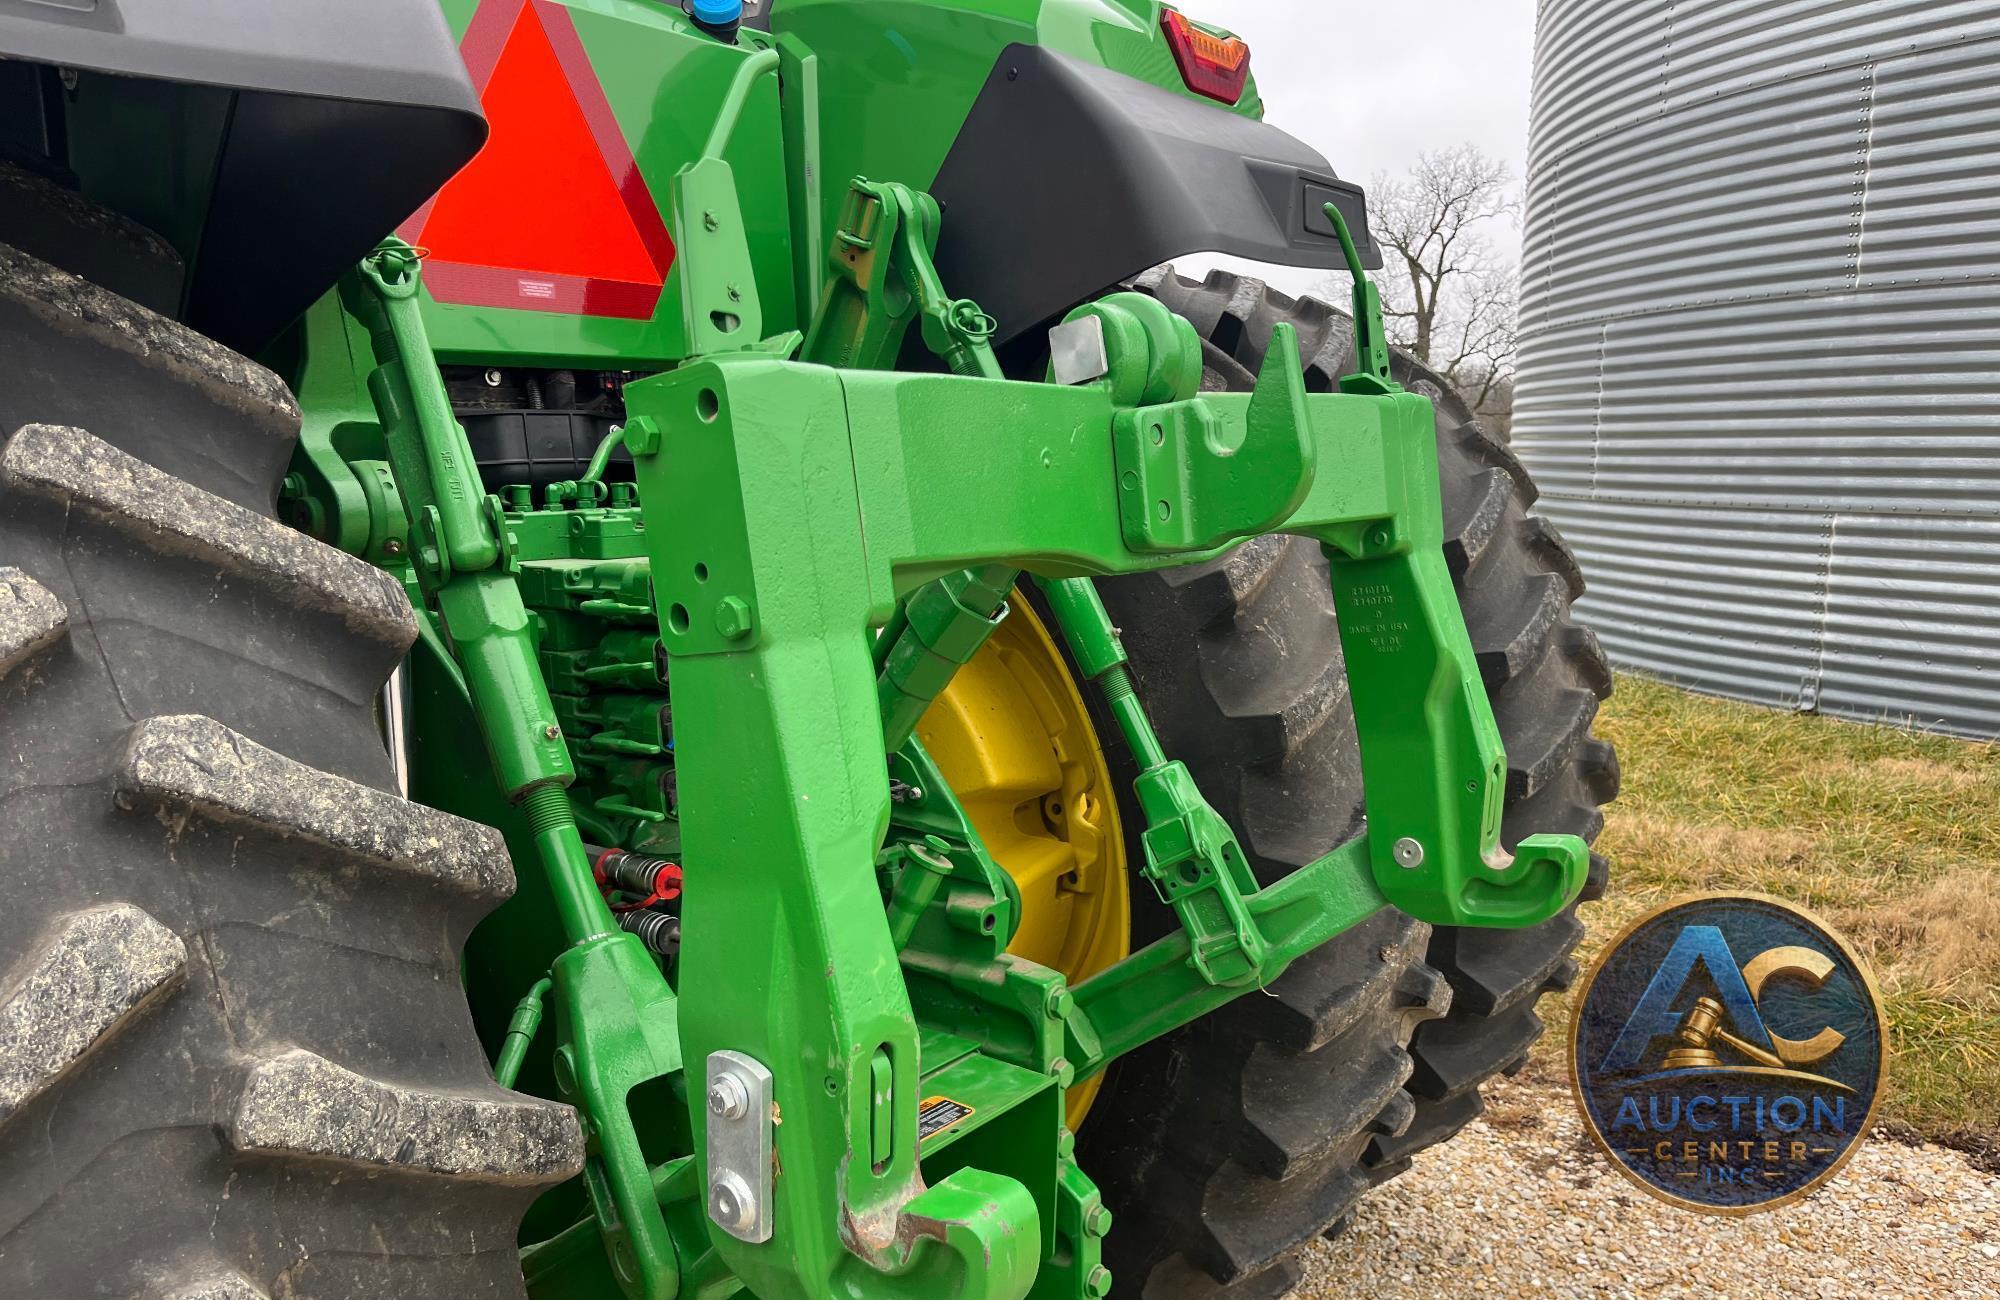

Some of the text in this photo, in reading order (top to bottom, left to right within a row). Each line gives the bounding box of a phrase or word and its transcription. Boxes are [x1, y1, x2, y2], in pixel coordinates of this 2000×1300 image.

[1348, 622, 1409, 634] MADE IN USA
